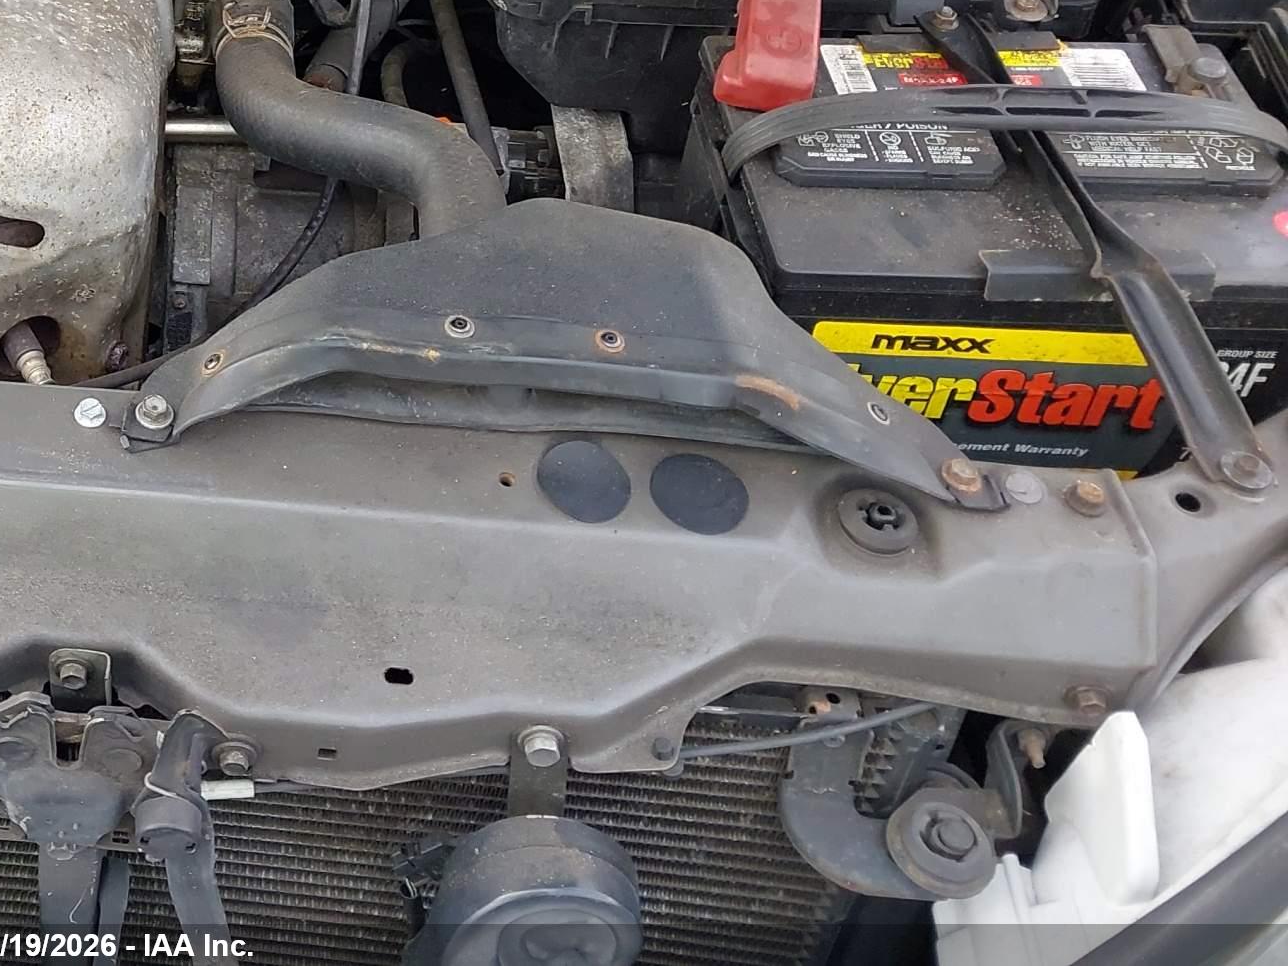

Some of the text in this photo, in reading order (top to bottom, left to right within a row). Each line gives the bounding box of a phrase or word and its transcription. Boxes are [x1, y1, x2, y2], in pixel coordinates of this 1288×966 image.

[871, 334, 996, 355] maxx
[1216, 350, 1279, 359] GROUP SIZE
[1014, 444, 1089, 457] Warranty
